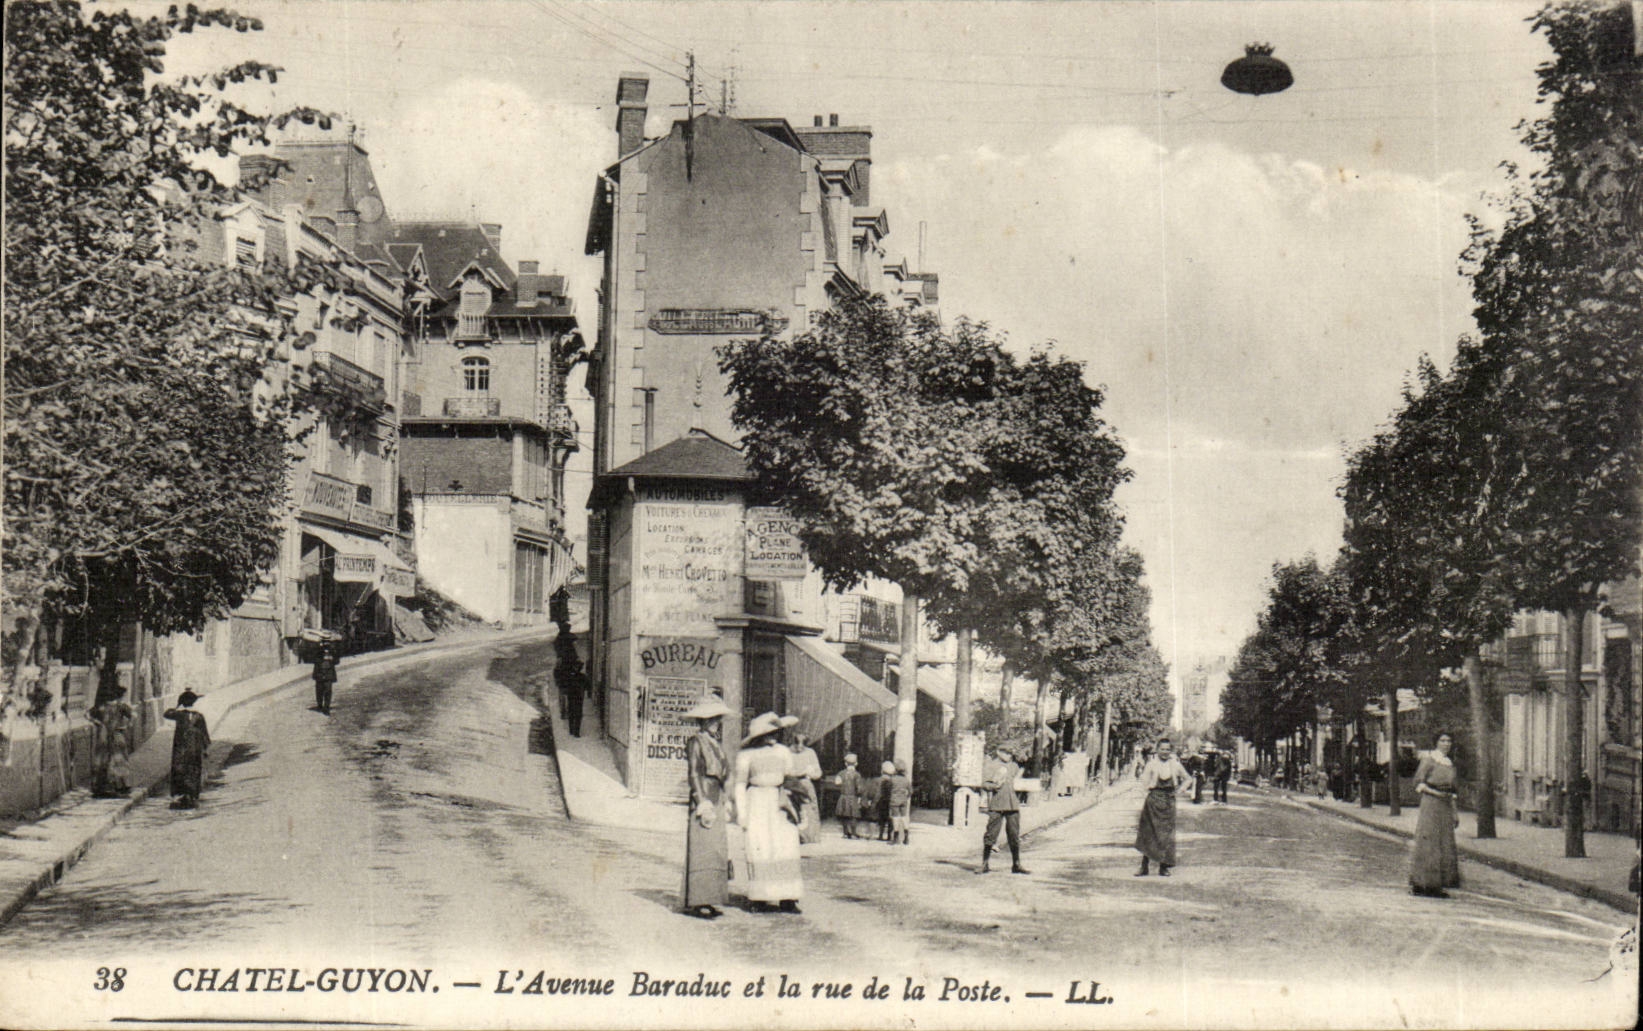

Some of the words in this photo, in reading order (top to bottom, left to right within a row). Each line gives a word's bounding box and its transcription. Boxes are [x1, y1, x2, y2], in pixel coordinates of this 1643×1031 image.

[747, 520, 801, 541] AGENC
[750, 551, 803, 561] LOCATION
[641, 643, 720, 669] BUREAU
[651, 734, 664, 745] LE
[667, 734, 688, 746] CŒU
[647, 744, 689, 760] DISPOS
